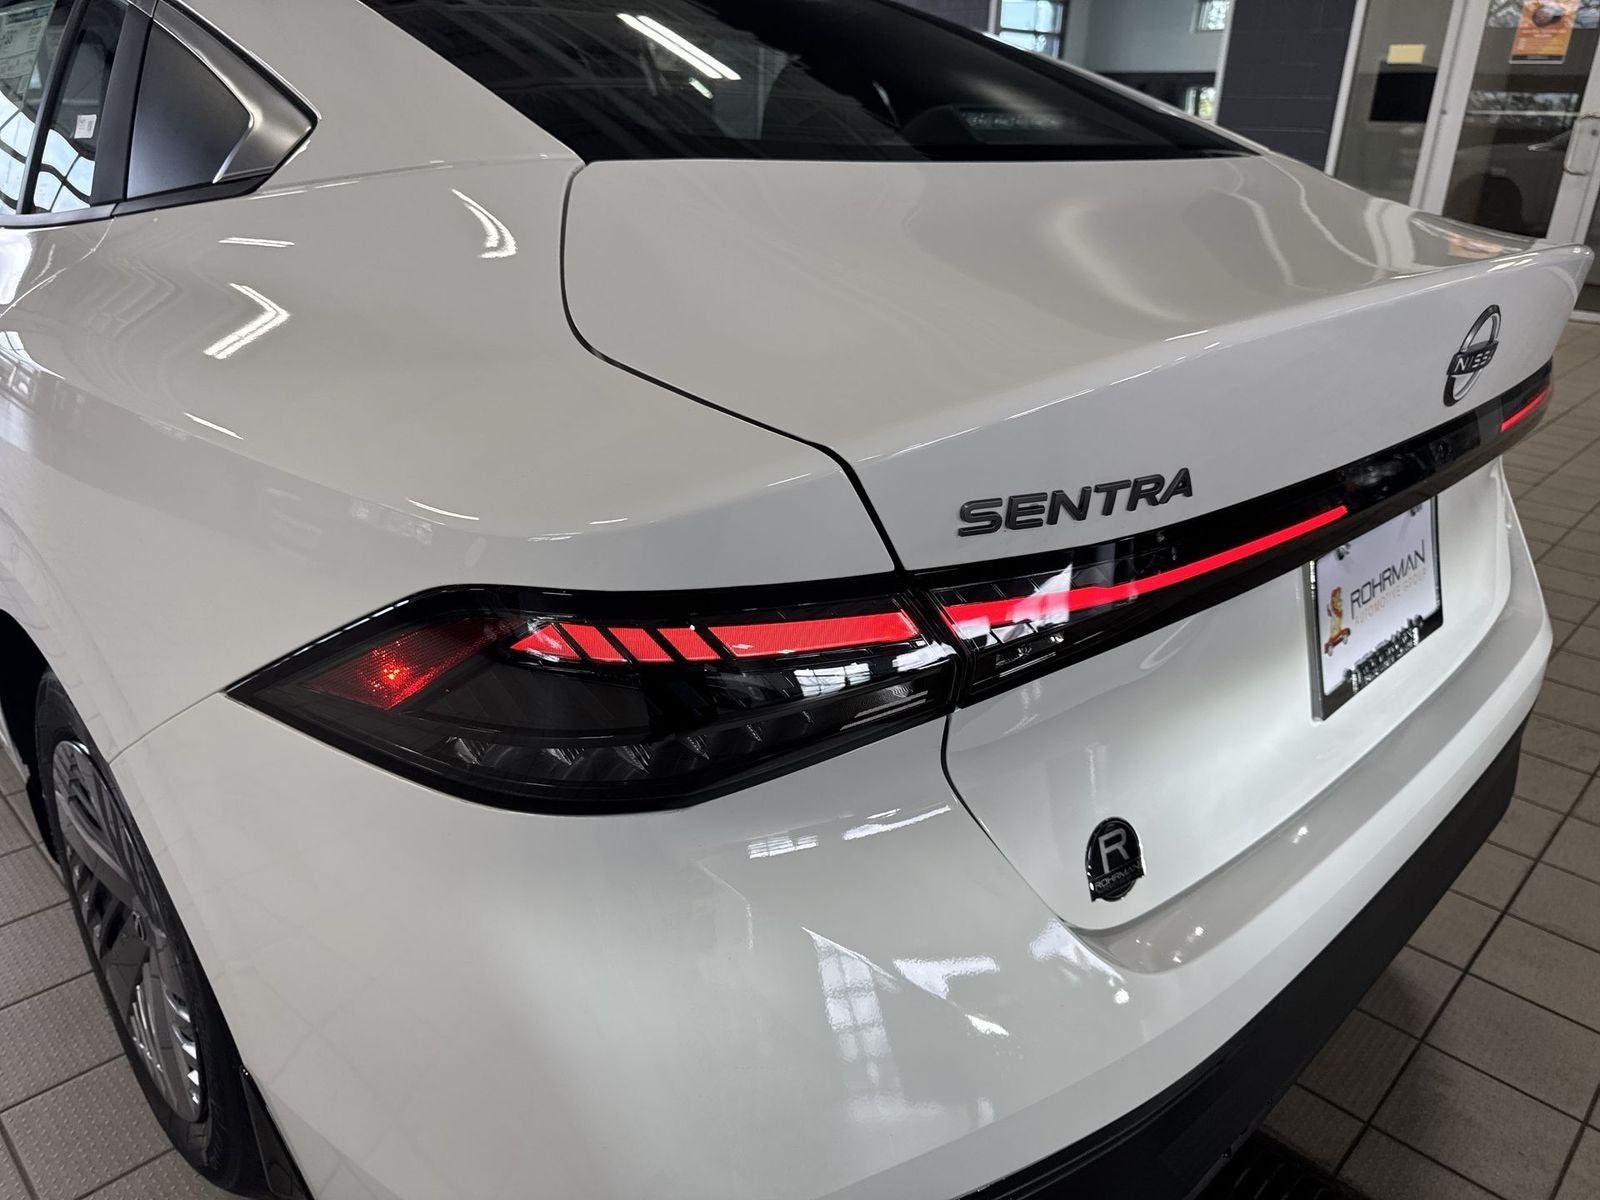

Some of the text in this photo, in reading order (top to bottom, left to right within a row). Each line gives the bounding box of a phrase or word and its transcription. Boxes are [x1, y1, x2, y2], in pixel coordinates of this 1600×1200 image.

[958, 467, 1193, 537] SENTRA
[1350, 538, 1426, 620] ROHRMAN
[1098, 827, 1130, 874] R
